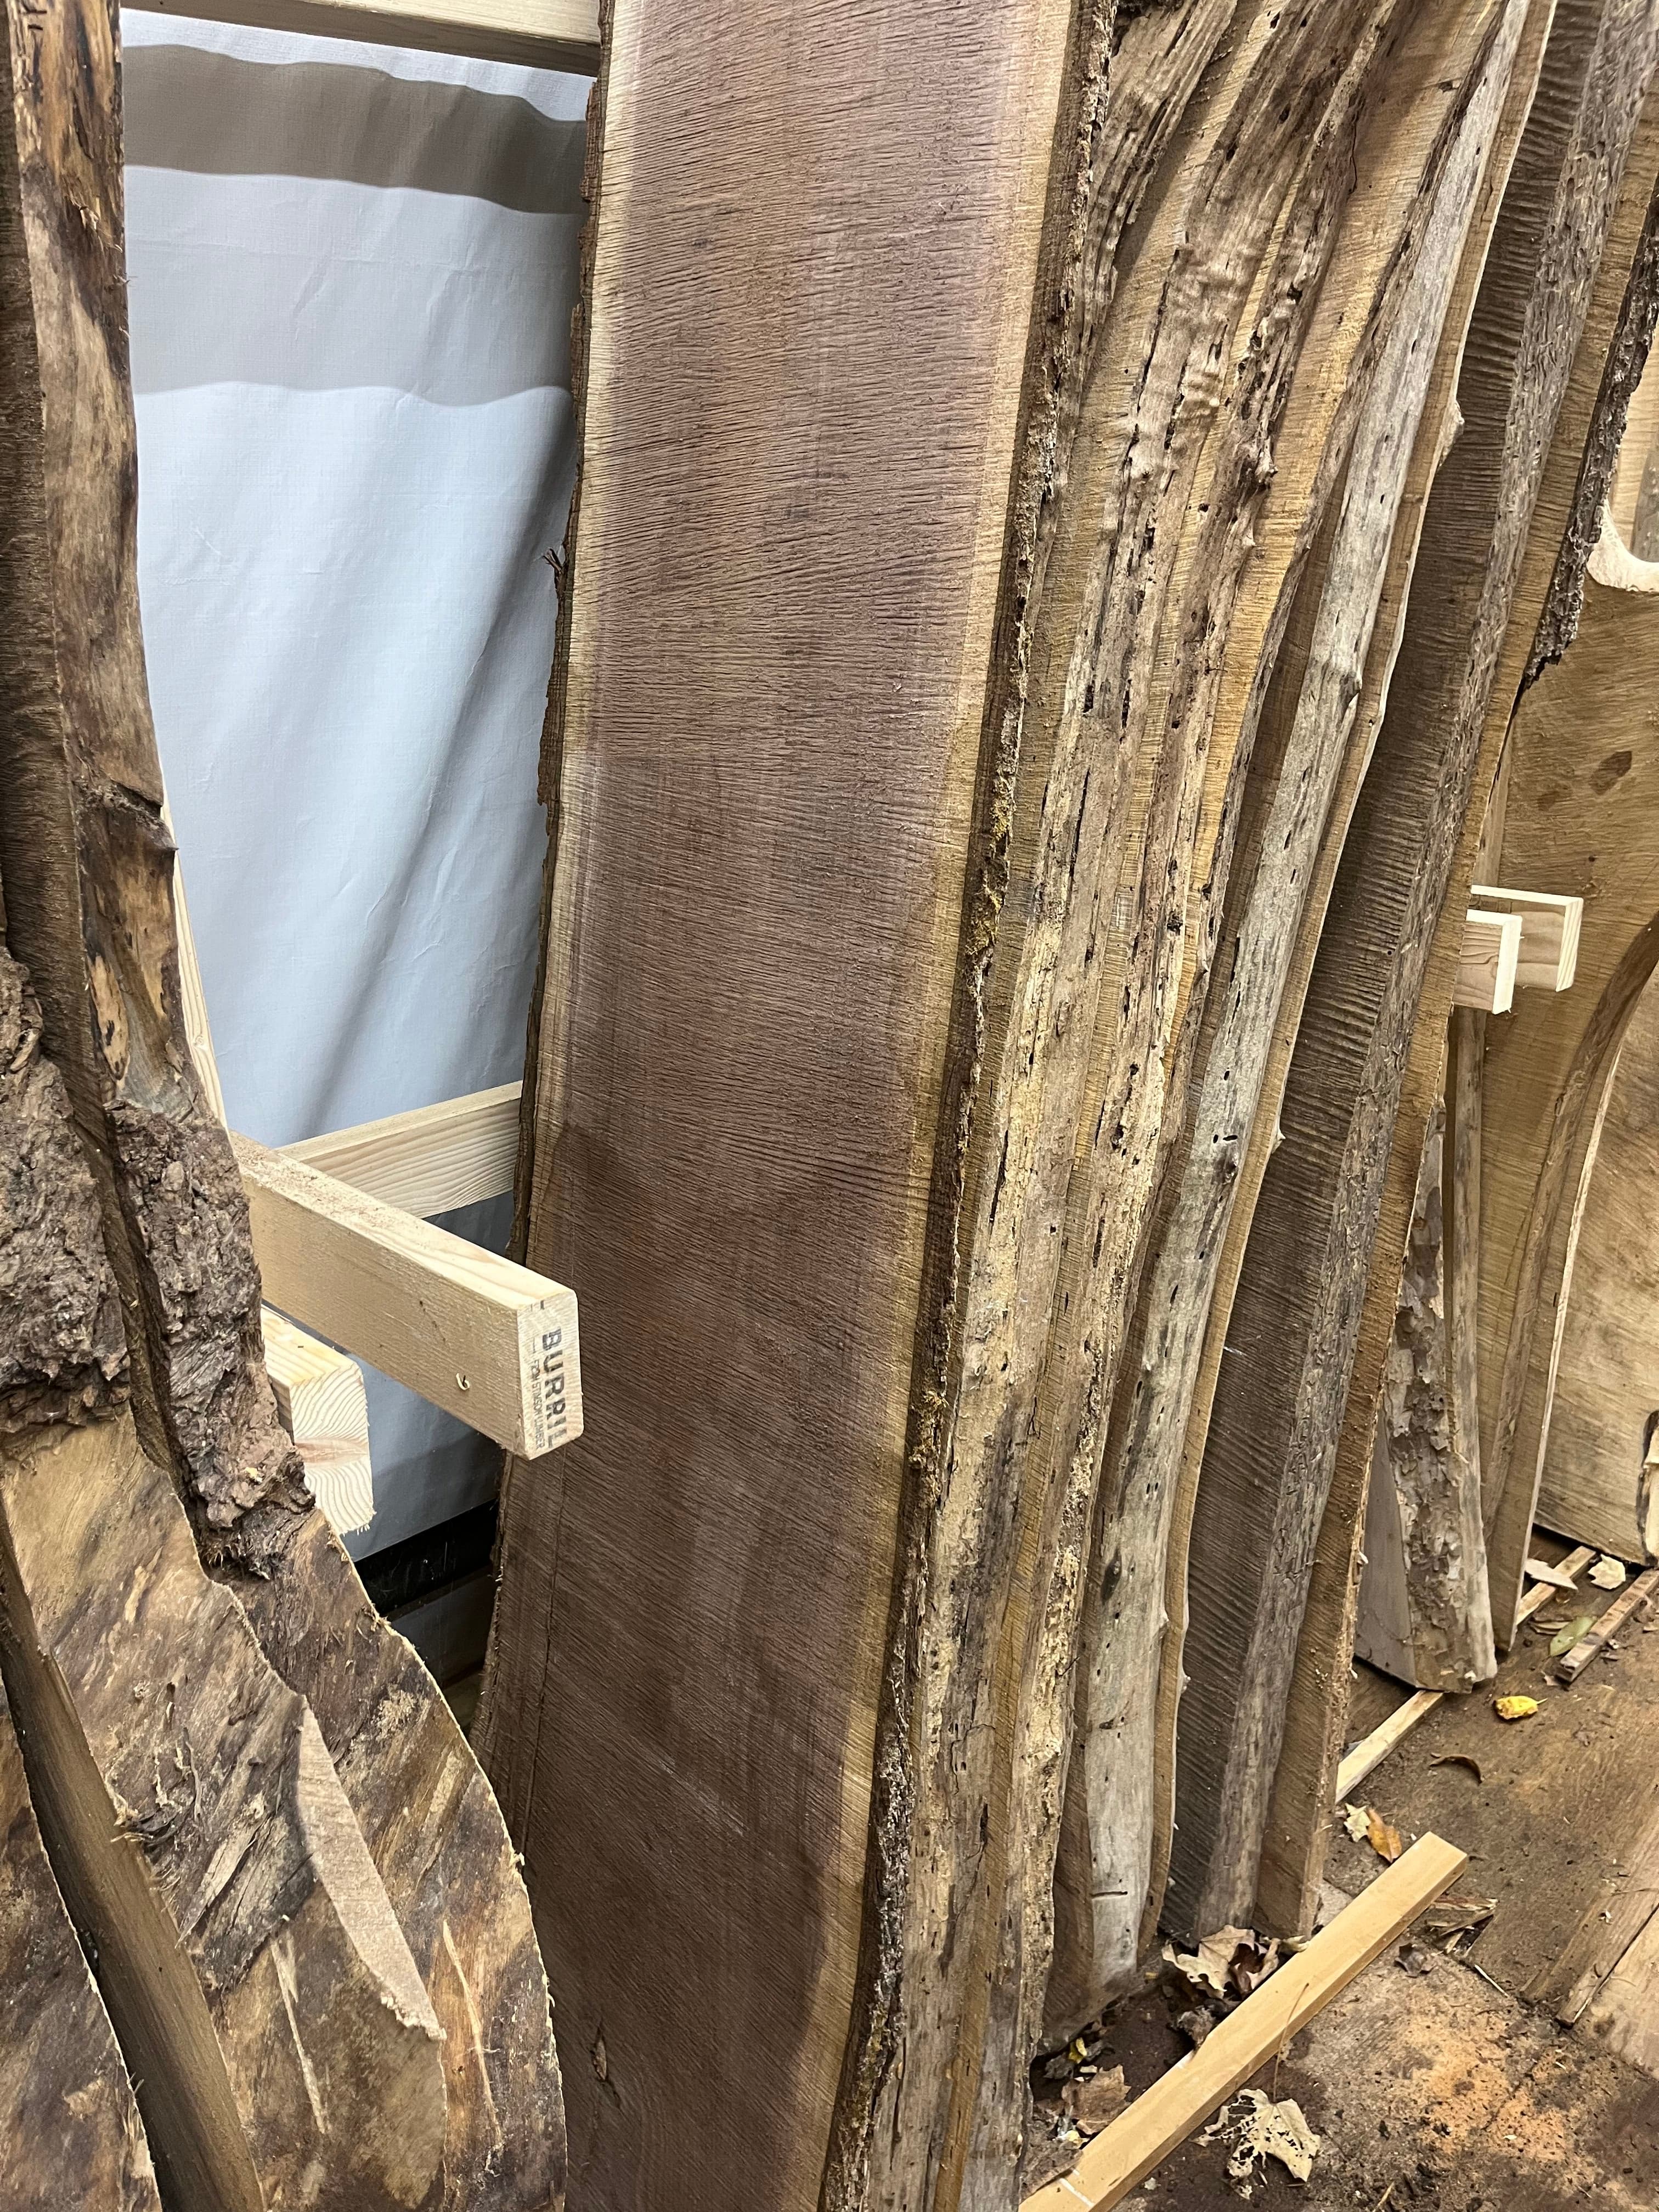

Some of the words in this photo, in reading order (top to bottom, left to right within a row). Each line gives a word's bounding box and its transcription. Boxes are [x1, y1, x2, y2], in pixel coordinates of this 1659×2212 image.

[531, 1359, 540, 1381] FROM
[532, 1382, 543, 1415] STIMSON
[534, 1416, 545, 1449] LUMBER
